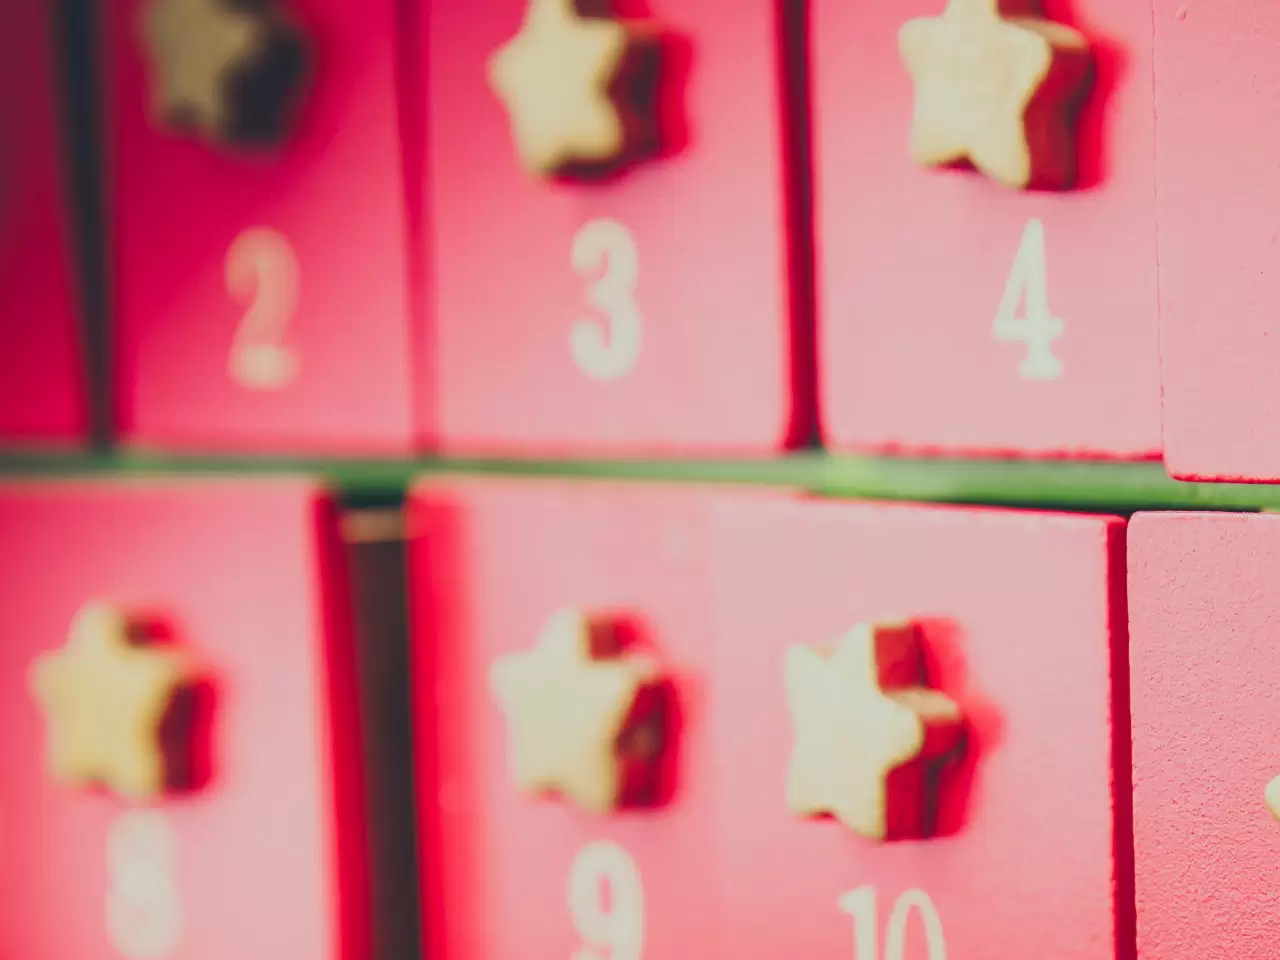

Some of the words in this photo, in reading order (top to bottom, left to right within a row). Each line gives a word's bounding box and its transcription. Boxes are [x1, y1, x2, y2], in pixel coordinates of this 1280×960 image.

[224, 226, 301, 390] 2
[568, 218, 644, 382] 3
[992, 218, 1066, 382] 4
